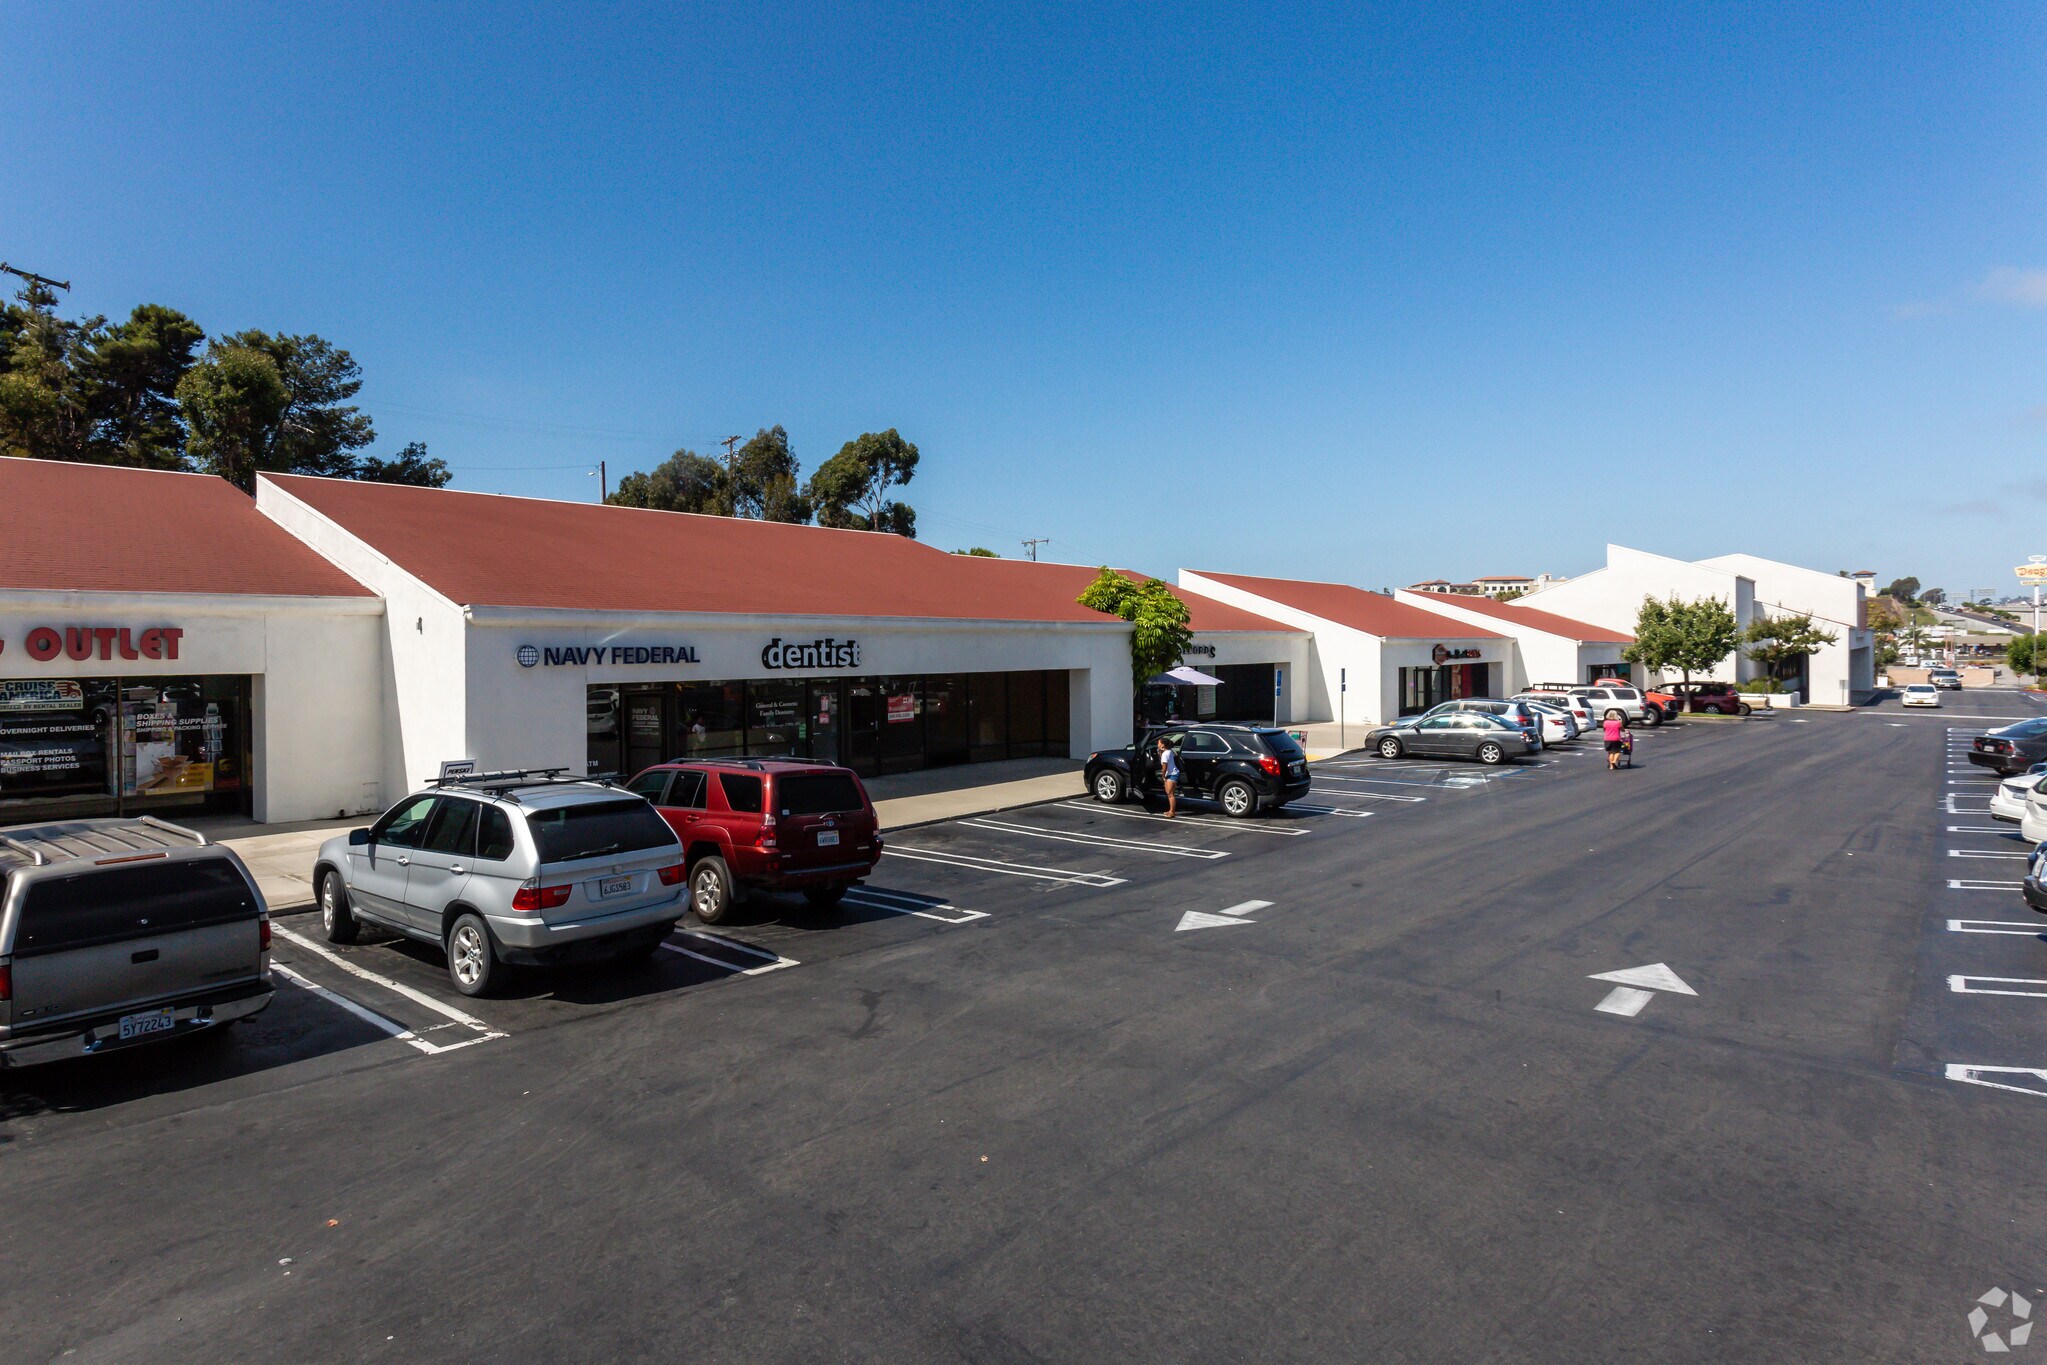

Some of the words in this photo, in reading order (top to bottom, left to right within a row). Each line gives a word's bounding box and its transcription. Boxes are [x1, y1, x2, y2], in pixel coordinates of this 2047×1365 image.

[26, 627, 183, 661] OUTLET
[543, 647, 606, 666] NAVY
[611, 647, 700, 664] FEDERAL
[762, 638, 860, 669] dentist
[5, 681, 56, 691] CRUISE
[0, 690, 62, 700] AMERICA
[136, 720, 177, 728] SHIPPING
[179, 717, 219, 725] SUPPLIES
[0, 726, 48, 735] OVERNIGHT
[49, 724, 95, 733] DELIVERIES
[37, 748, 73, 756] RENTALS
[1, 757, 43, 766] PASSPORT
[44, 755, 76, 763] PHOTOS
[0, 765, 41, 774] BUSINESS
[42, 763, 80, 771] SERVICES
[123, 1016, 171, 1036] 5Y72243
